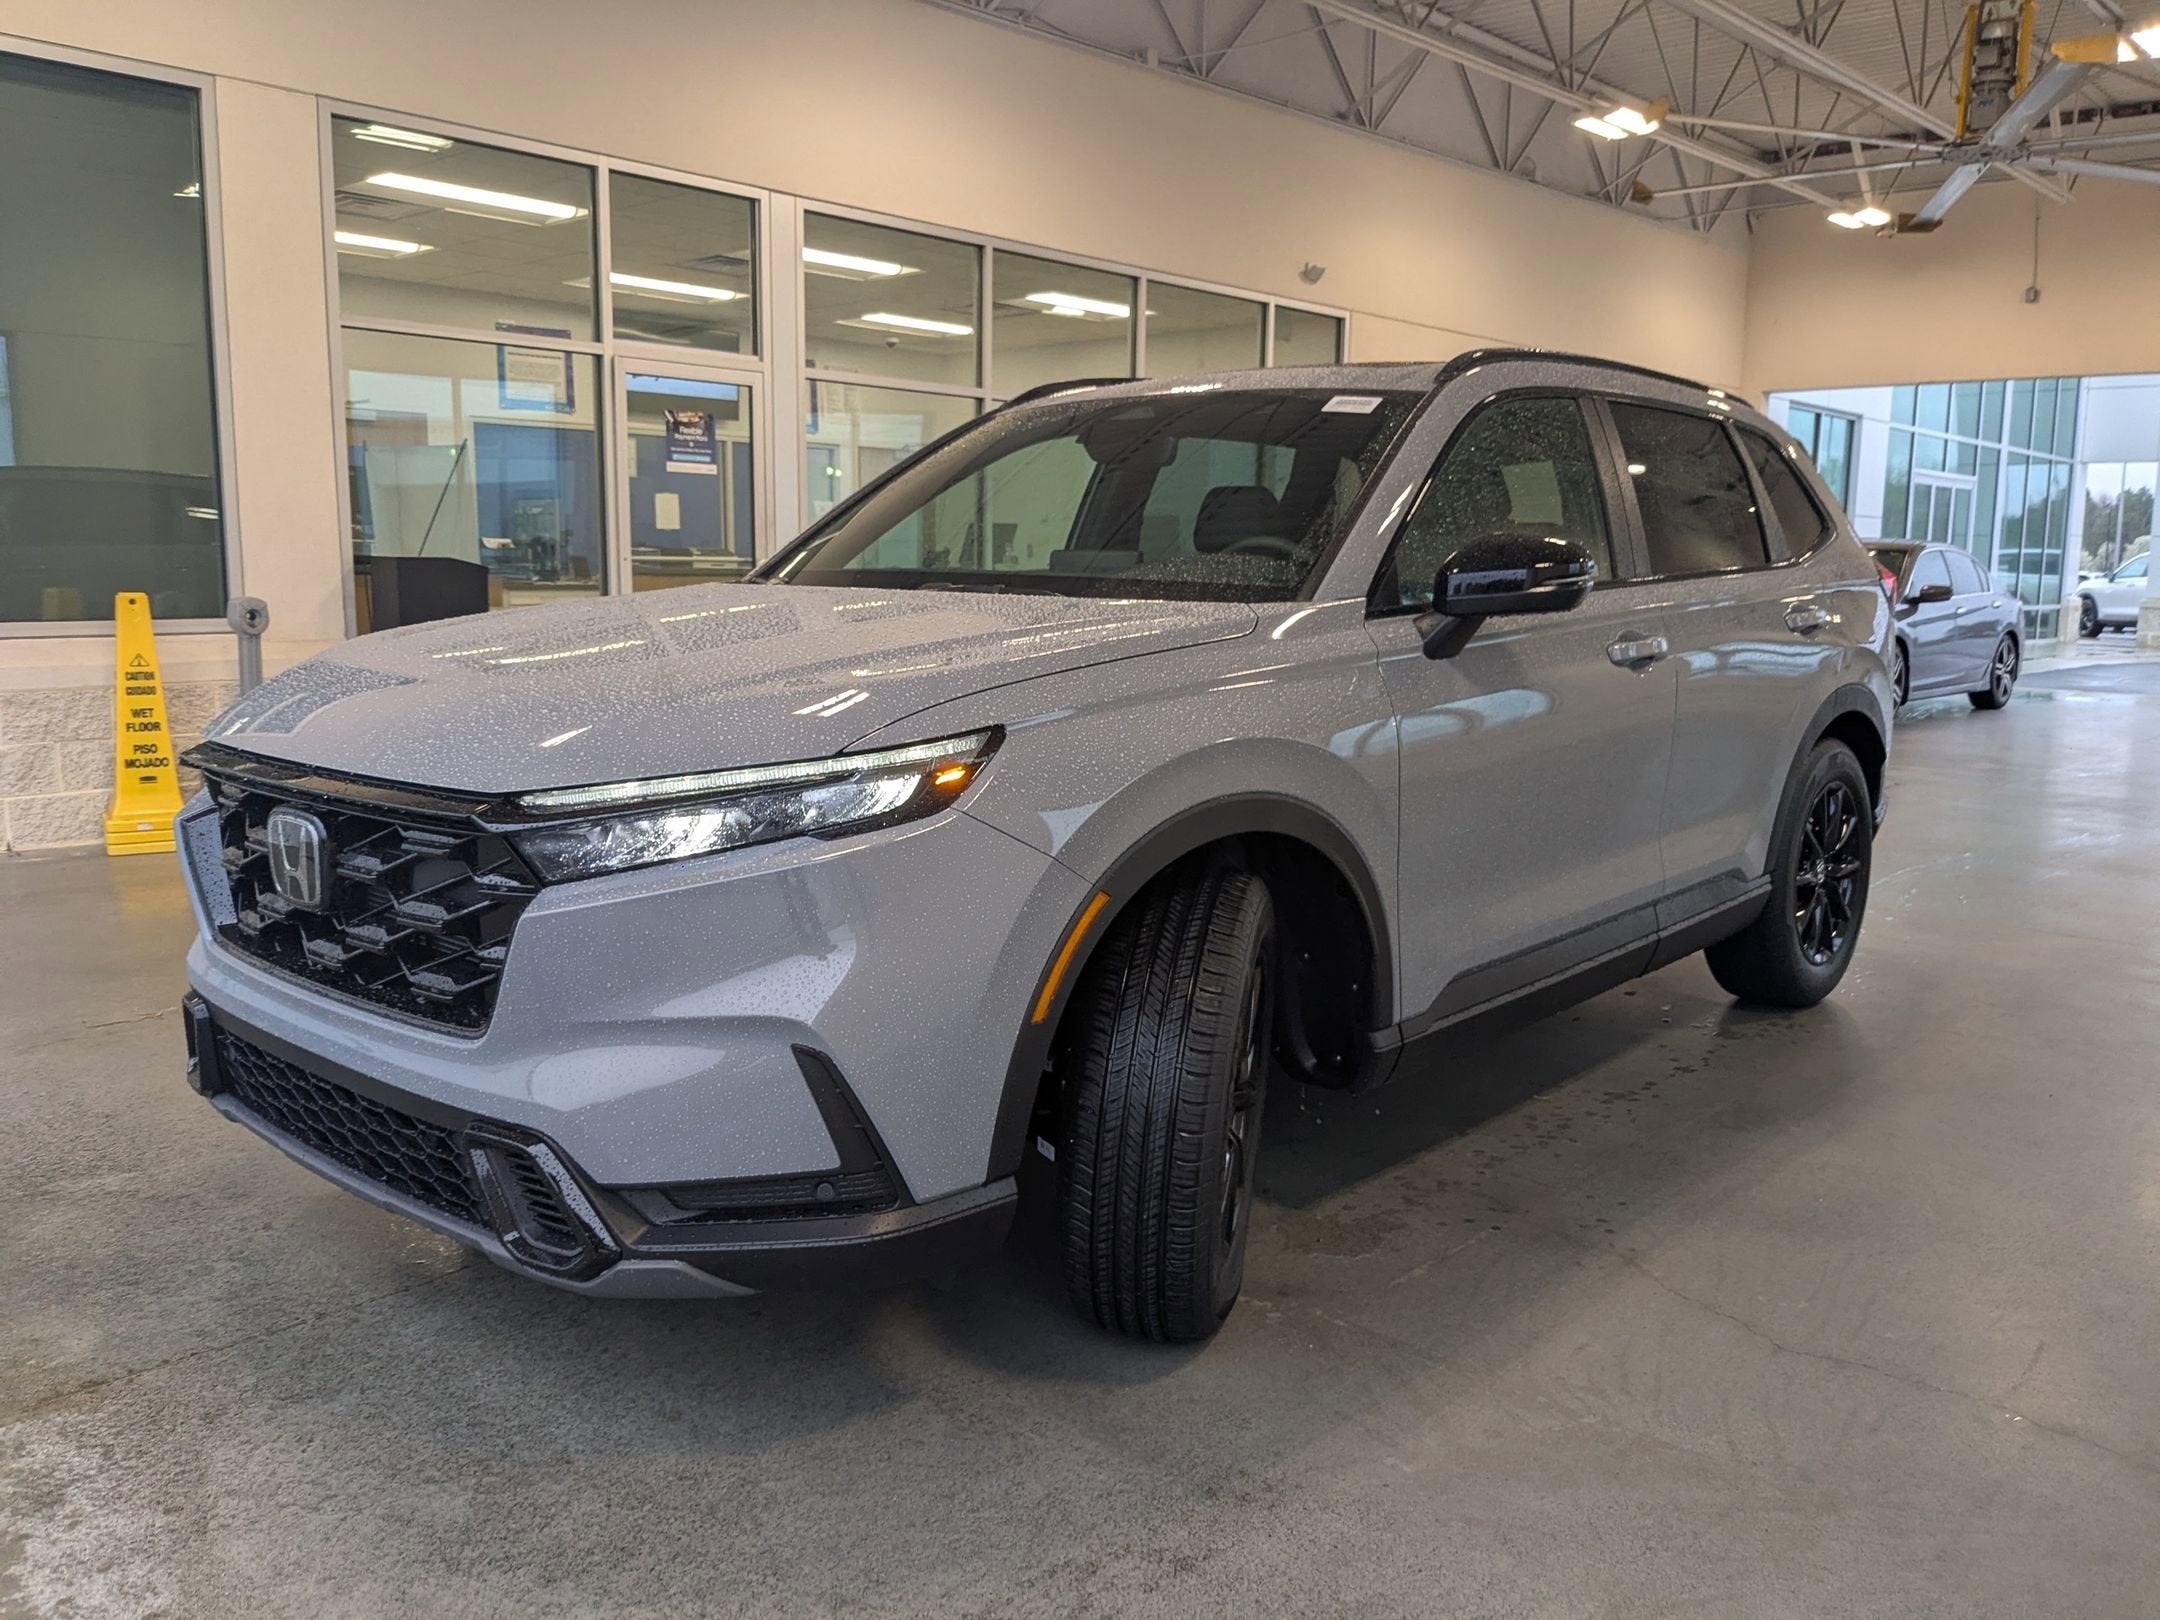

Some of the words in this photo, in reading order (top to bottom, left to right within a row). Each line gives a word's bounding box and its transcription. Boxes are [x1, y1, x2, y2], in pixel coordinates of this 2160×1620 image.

[125, 671, 155, 681] CAUTION
[126, 686, 156, 696] CUIDADO
[130, 708, 154, 718] WET
[126, 722, 161, 732] FLOOR
[133, 744, 158, 754] PISO
[124, 757, 169, 769] MOJADO
